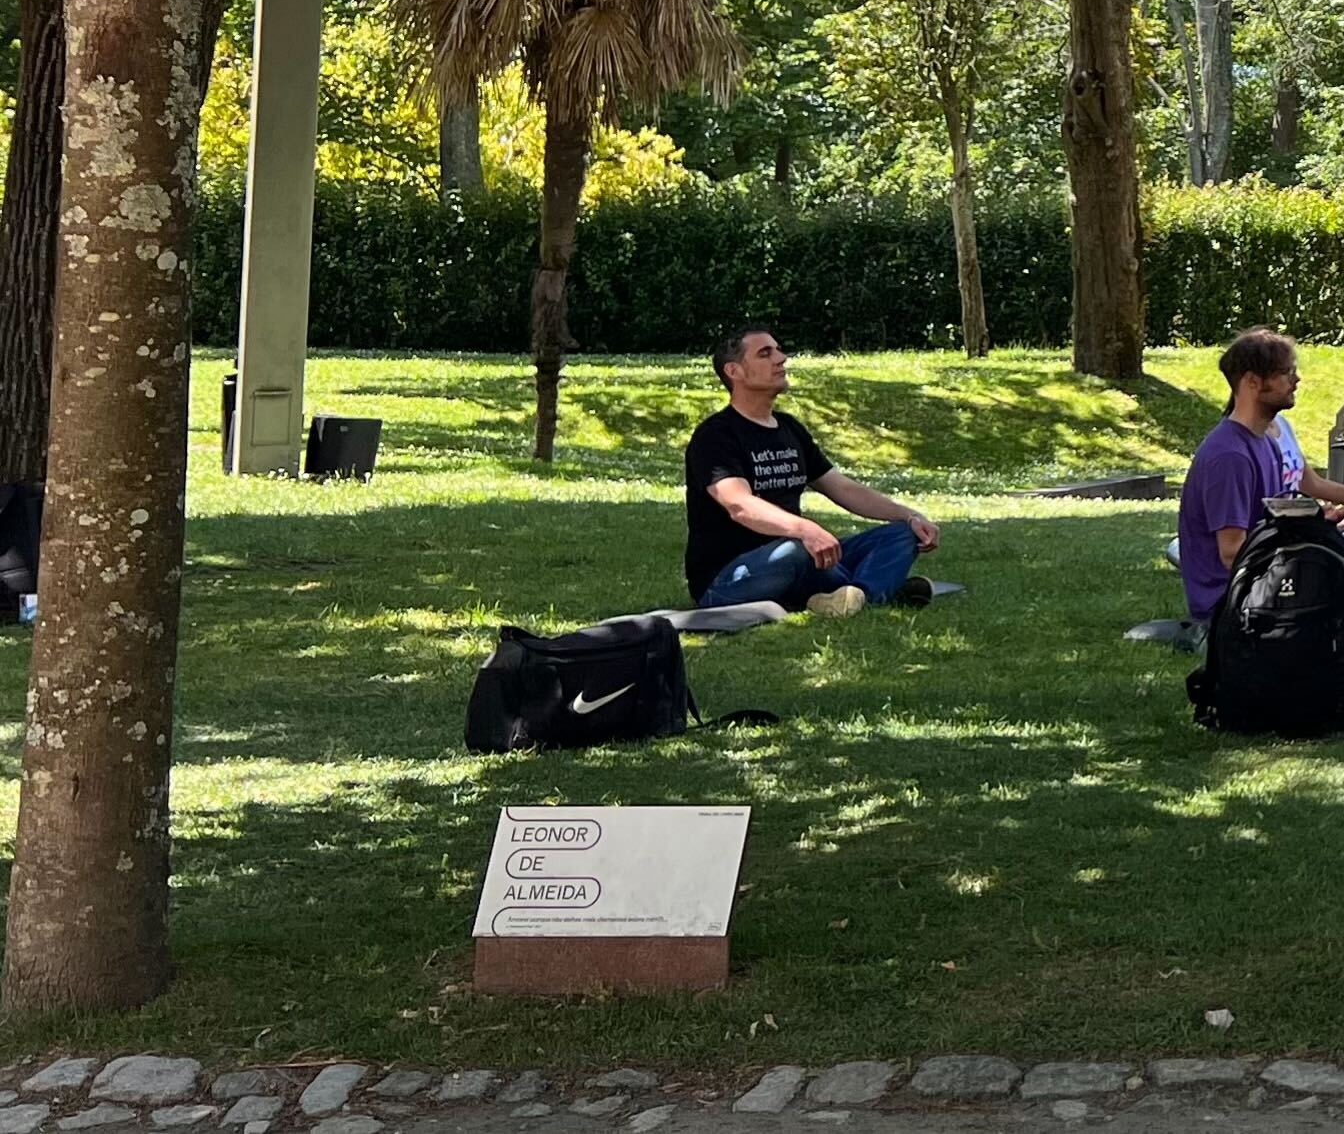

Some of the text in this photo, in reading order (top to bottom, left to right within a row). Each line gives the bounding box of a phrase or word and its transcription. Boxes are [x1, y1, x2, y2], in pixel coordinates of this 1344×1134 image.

[751, 447, 798, 462] Let's make
[754, 462, 799, 476] the web a
[754, 478, 786, 490] better
[510, 827, 588, 842] LEONOR
[519, 856, 546, 871] DE
[503, 884, 587, 901] ALMEIDA
